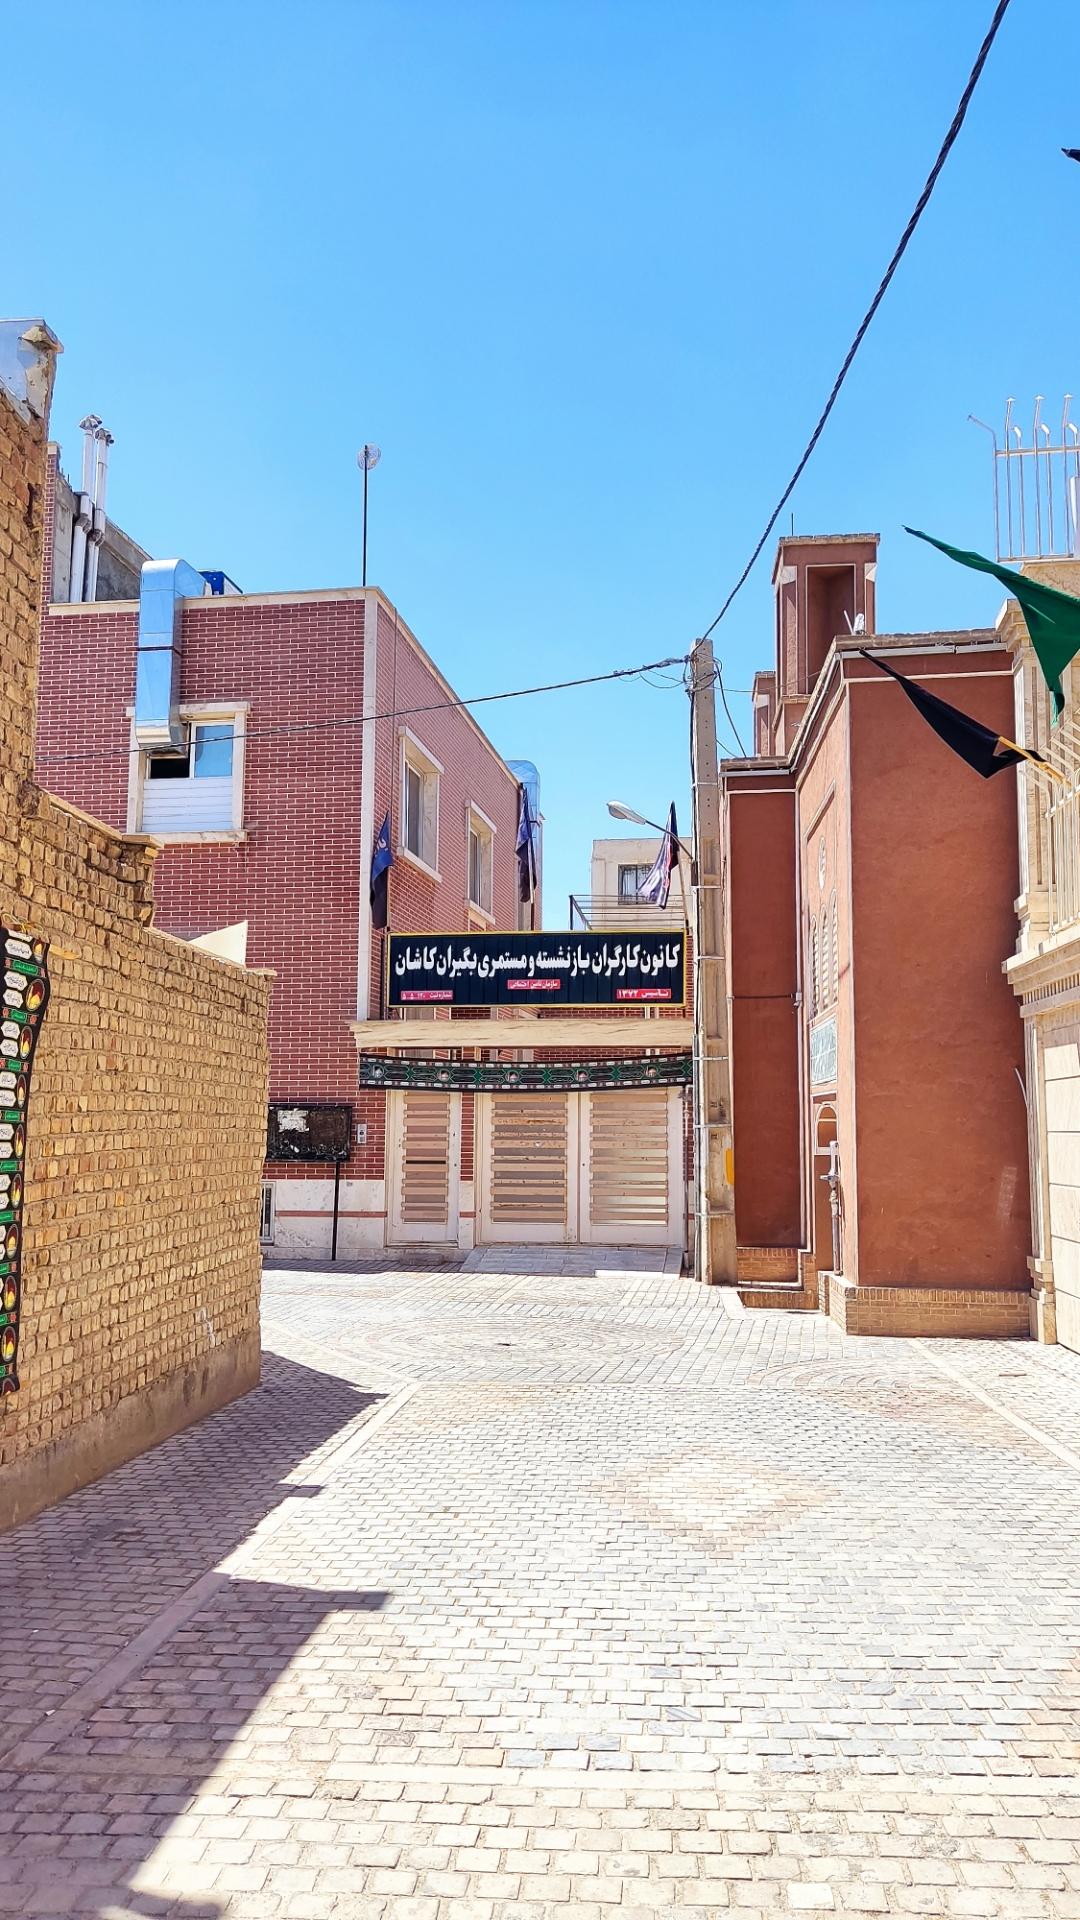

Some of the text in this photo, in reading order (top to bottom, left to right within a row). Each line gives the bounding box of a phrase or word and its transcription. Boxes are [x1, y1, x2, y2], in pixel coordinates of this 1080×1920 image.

[395, 943, 681, 978] کانون کارگران بازنشسته و مستمری بگیران کاشان
